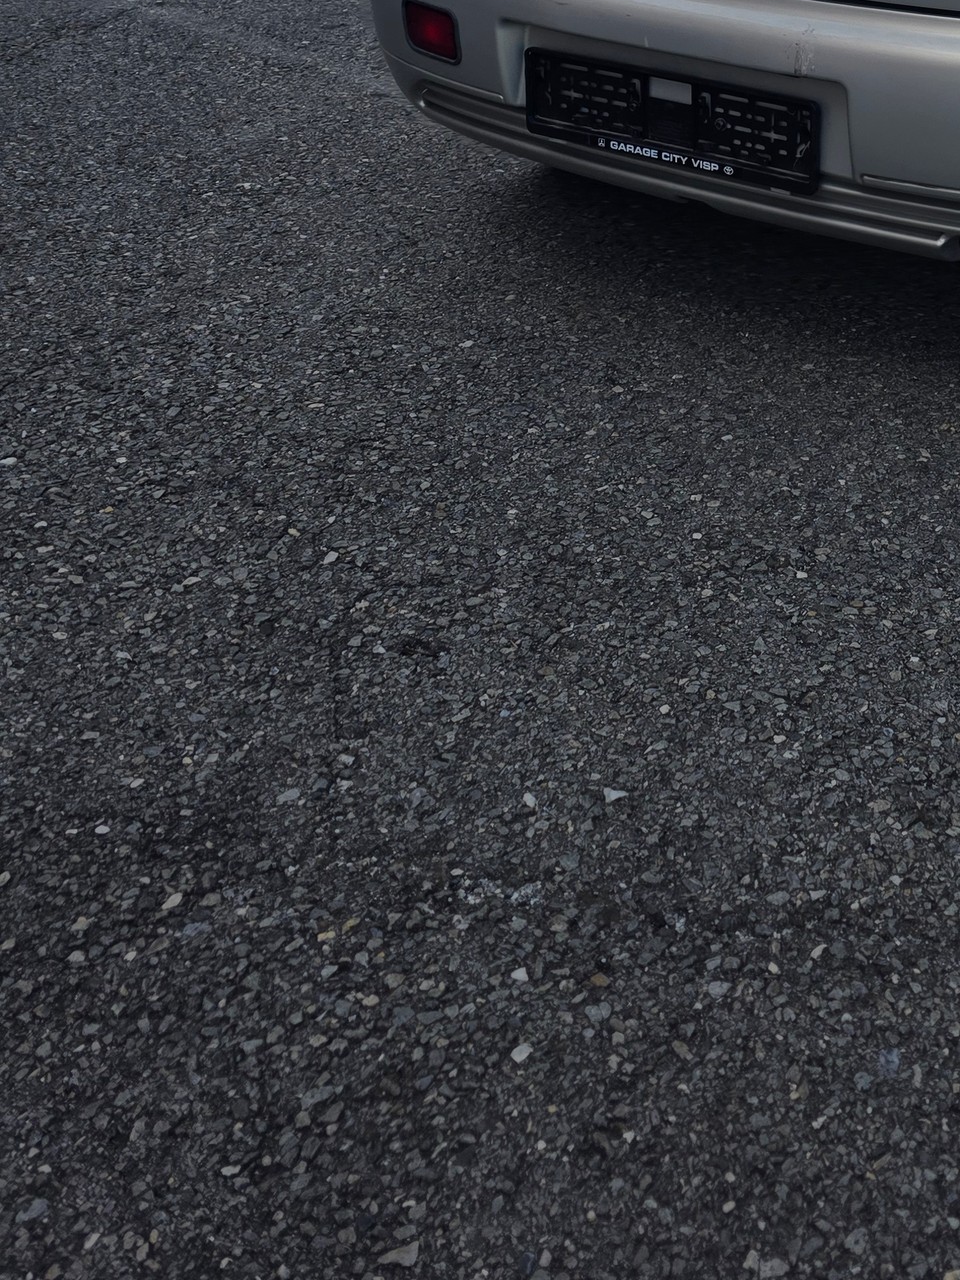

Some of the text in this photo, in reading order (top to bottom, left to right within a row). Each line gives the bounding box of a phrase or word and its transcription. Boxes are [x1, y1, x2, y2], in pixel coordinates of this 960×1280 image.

[610, 141, 719, 172] GARAGE CITY VISP
